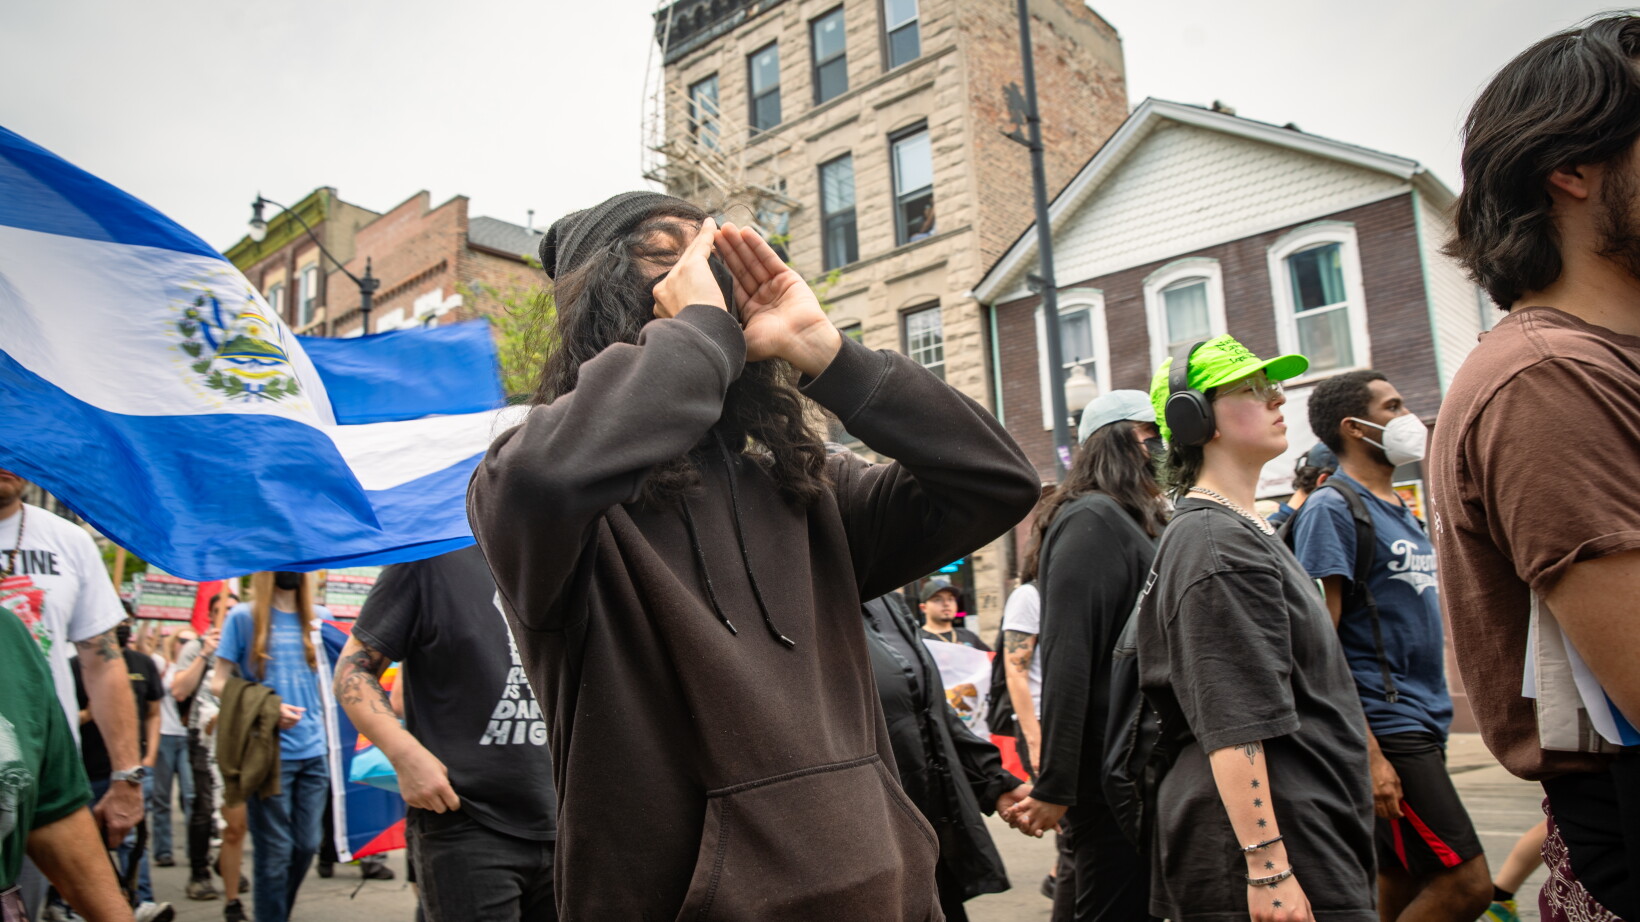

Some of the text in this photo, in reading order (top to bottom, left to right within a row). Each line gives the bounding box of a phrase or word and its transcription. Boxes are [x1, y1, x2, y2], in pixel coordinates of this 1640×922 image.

[0, 549, 61, 576] TINE
[501, 684, 520, 699] IS
[479, 720, 547, 746] HIG
